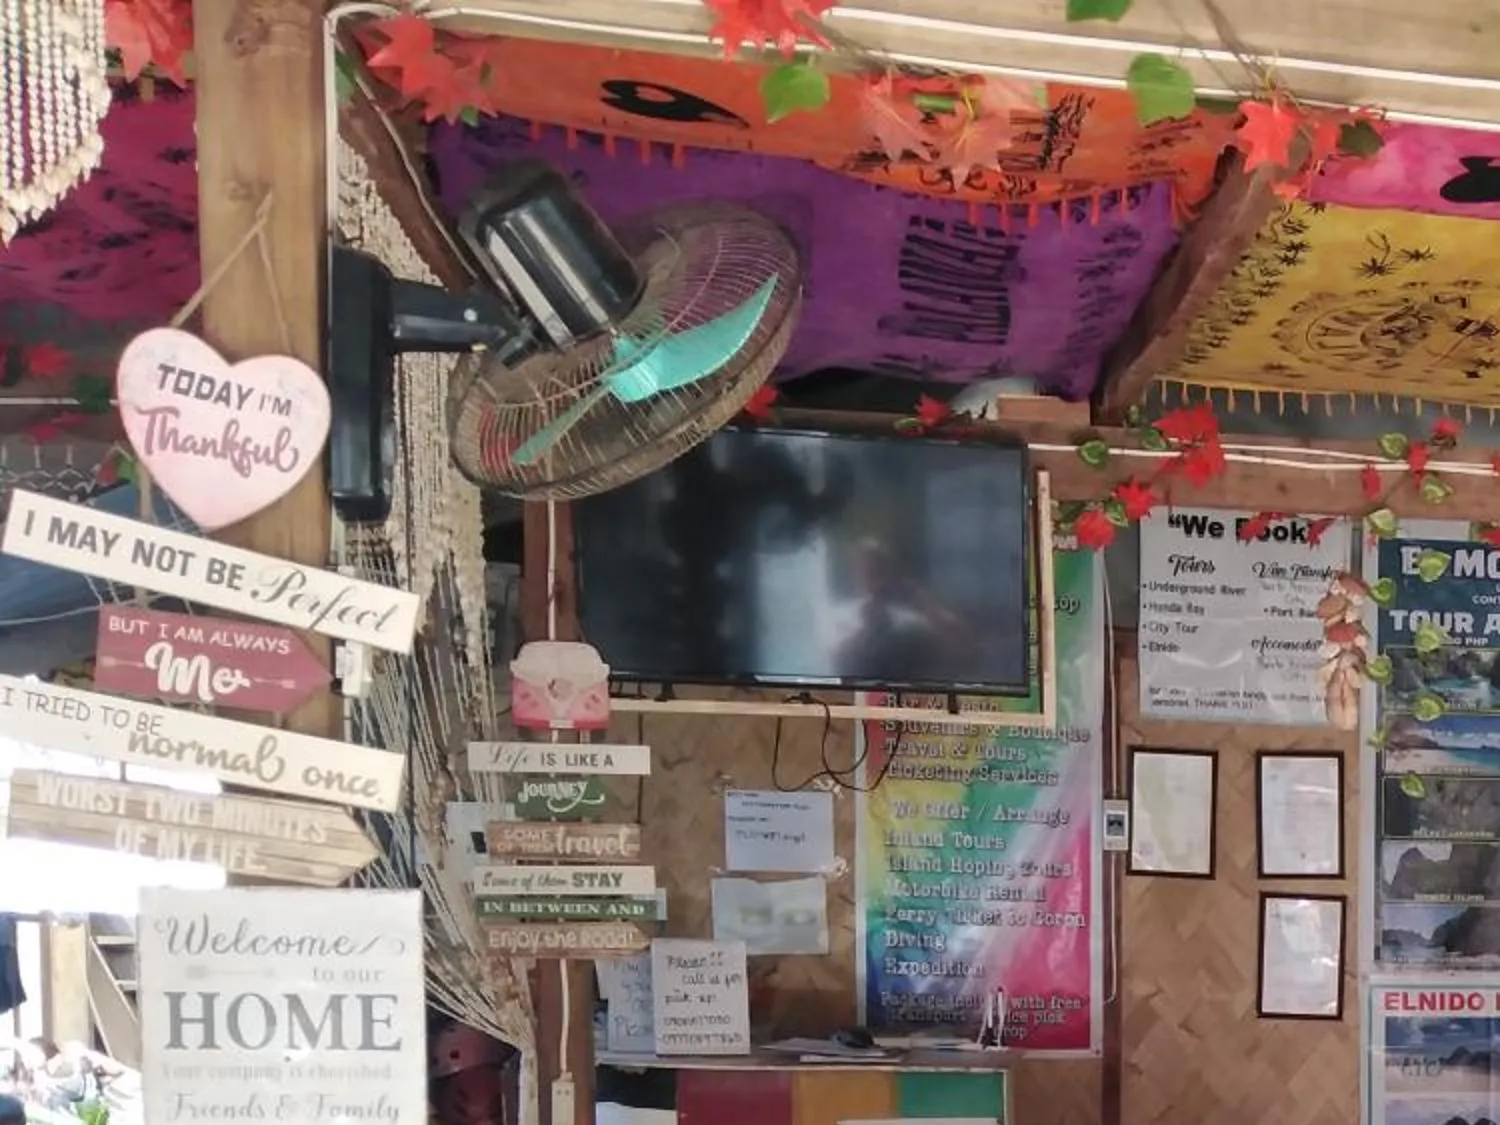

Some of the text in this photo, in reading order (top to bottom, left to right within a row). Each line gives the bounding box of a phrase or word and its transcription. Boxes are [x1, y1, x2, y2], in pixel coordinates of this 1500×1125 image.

[157, 364, 293, 417] TODAY I'M
[135, 405, 299, 478] Thankful
[23, 509, 400, 633] I MAY NOT BE Perfect
[1168, 553, 1216, 577] Tours
[1150, 582, 1216, 596] Underground
[1176, 622, 1199, 634] Tour
[1389, 608, 1476, 635] TOUR
[108, 616, 292, 656] BUT I AM ALWAYS
[143, 641, 251, 702] Me
[2, 686, 164, 736] I TRIED TO BE
[540, 753, 558, 768] IS
[565, 754, 599, 768] LIKE
[603, 755, 615, 768] A
[974, 745, 1028, 762] Tours
[127, 731, 385, 804] normal once.
[35, 770, 328, 844] WORST TWO MINUTES
[517, 780, 605, 808] JOURNEY
[114, 822, 147, 853] OF
[157, 827, 196, 861] MY
[553, 824, 640, 857] travel
[953, 831, 1007, 849] Tours
[571, 872, 624, 888] STAY
[950, 856, 1017, 879] Hoping
[484, 901, 645, 915] IN BETWEEN AND
[154, 912, 402, 957] Welcome
[488, 927, 543, 954] Enjoy
[884, 929, 946, 953] Diving
[312, 965, 386, 984] to our
[884, 956, 985, 979] Expedition
[1011, 995, 1045, 1009] with
[1383, 991, 1486, 1013] ELNIDO
[163, 991, 405, 1051] HOME
[164, 1089, 268, 1122] Friends
